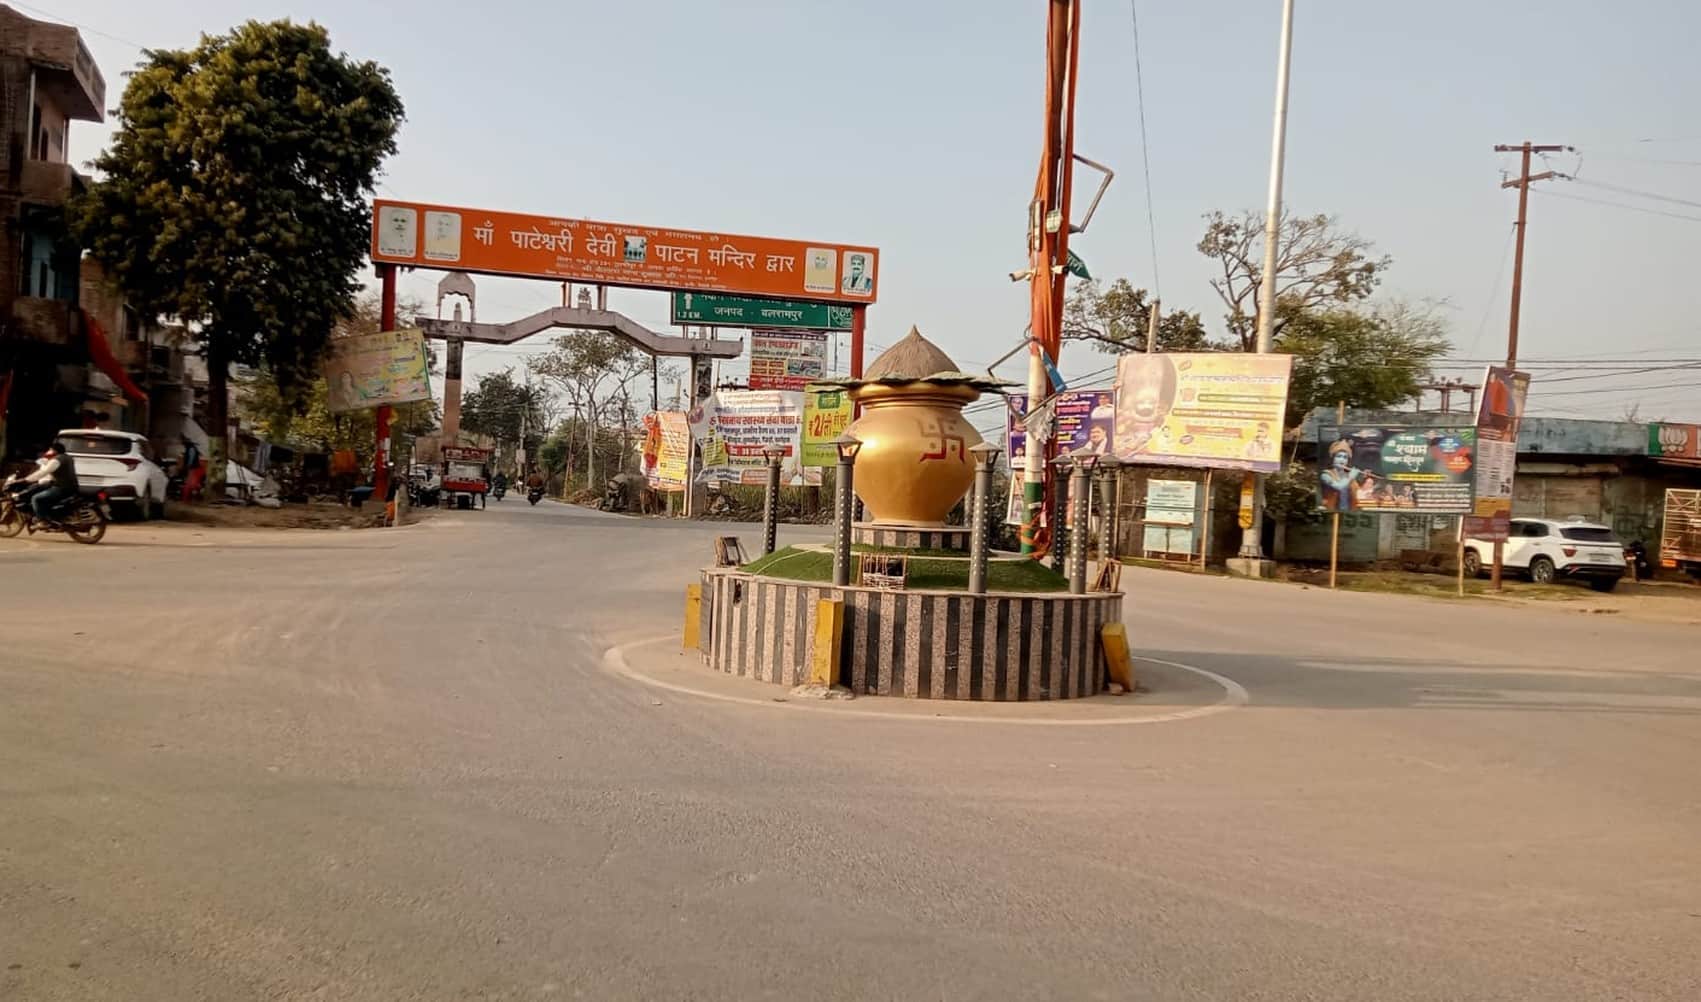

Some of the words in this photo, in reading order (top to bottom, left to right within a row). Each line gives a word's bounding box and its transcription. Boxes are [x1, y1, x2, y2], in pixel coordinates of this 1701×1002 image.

[473, 220, 493, 246] माँ
[510, 226, 573, 253] पाटेश्वरी
[585, 232, 617, 257] देवी
[655, 244, 699, 265] पाटन
[708, 244, 756, 269] मन्दिर
[765, 253, 795, 273] द्वार
[714, 306, 743, 317] जनपद
